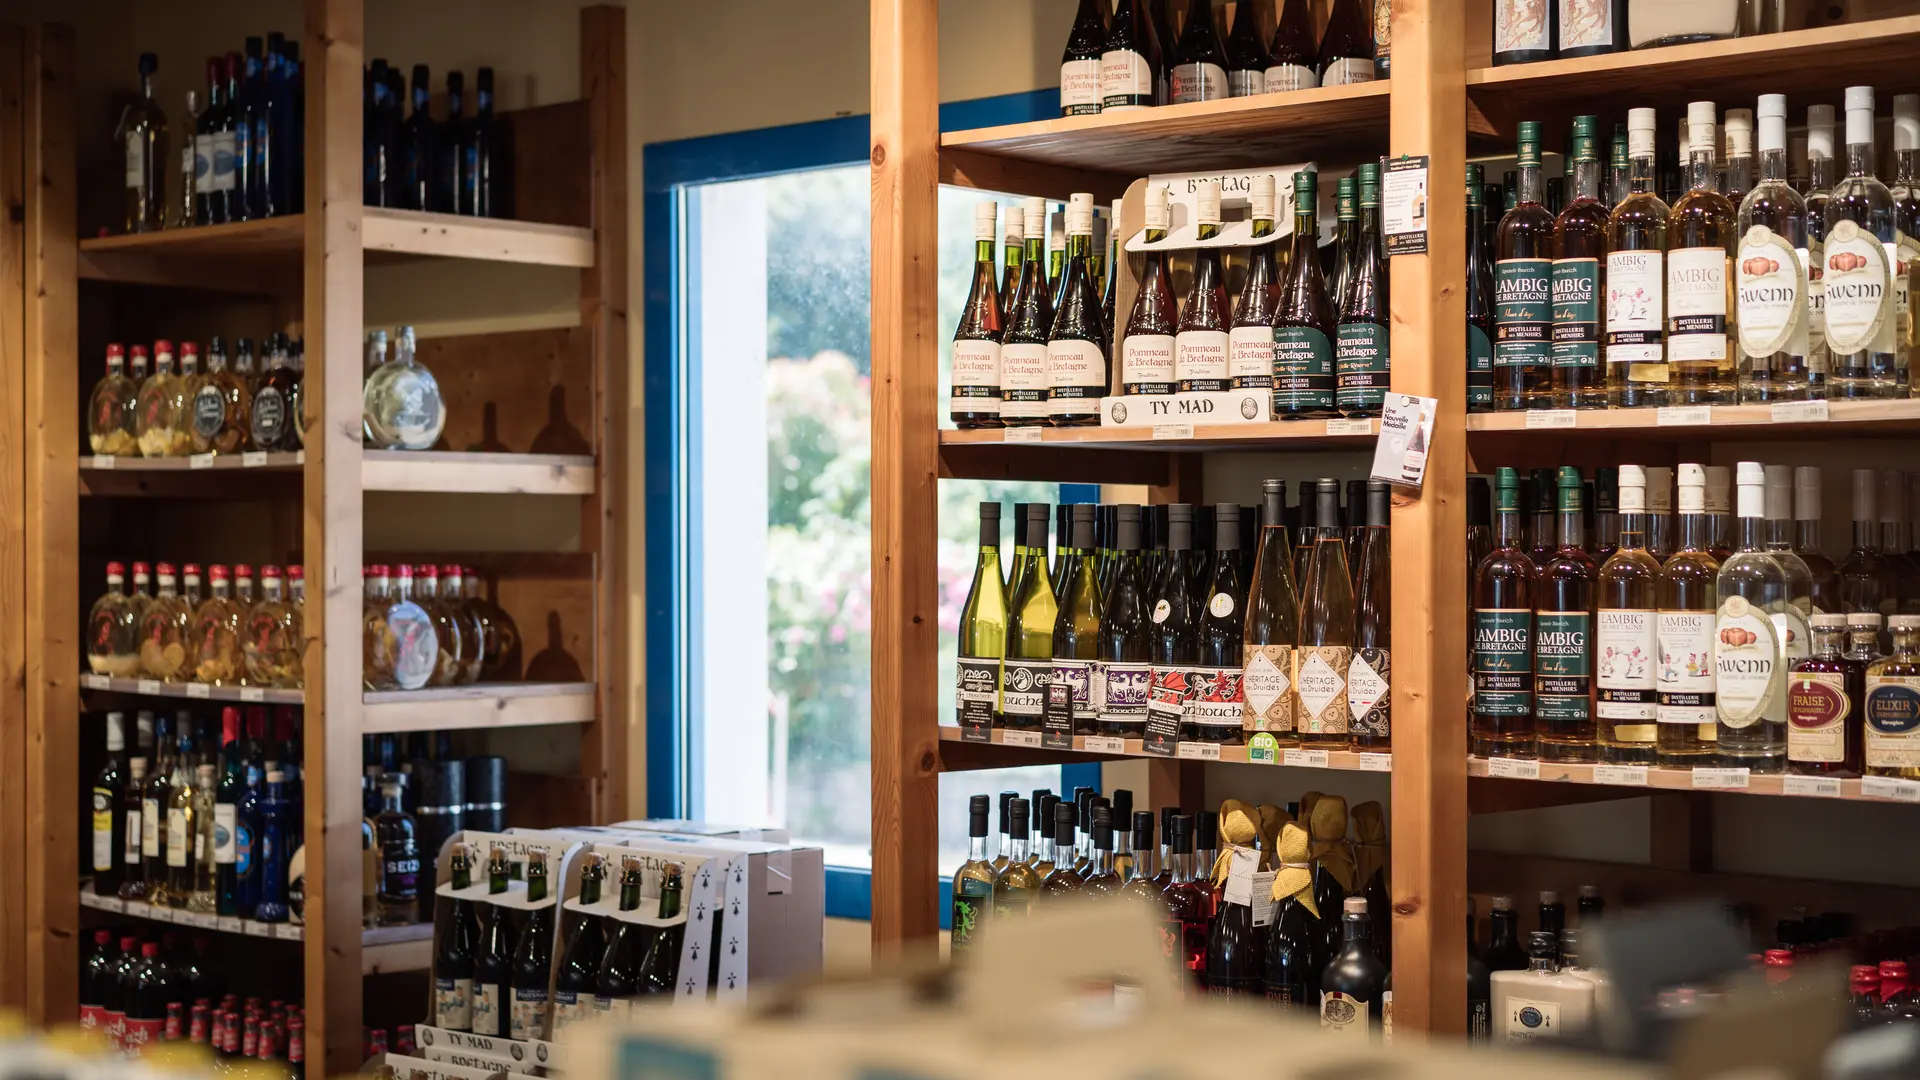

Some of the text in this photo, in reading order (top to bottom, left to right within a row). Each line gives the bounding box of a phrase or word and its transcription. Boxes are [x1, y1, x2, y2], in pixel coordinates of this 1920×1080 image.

[1608, 256, 1646, 267] LAMBIG
[1496, 278, 1548, 294] LAMBIG
[1503, 292, 1547, 300] BRETAGNE
[1232, 341, 1270, 349] Pommeau
[1272, 341, 1310, 350] Pommeau
[1338, 338, 1373, 346] Pommeau
[1130, 348, 1168, 357] Pommeau
[1181, 345, 1220, 353] Pommeau
[1341, 347, 1377, 356] Bretagne
[1187, 355, 1224, 364] Bretagne
[1238, 351, 1272, 360] Bretagn
[1277, 351, 1314, 360] Bretagne
[1004, 356, 1040, 365] Pommeau
[1136, 358, 1172, 367] Bretagne
[960, 362, 994, 371] Bretagne
[1008, 366, 1044, 375] Bretagne
[1054, 362, 1088, 371] Bretagne
[1150, 399, 1214, 414] TY MAD
[1386, 406, 1396, 414] Une
[1384, 414, 1408, 423] Nouvelle
[1601, 614, 1643, 625] LAMBIG
[1661, 616, 1701, 627] LAMBIG
[1475, 628, 1527, 642] LAMBIG
[1481, 642, 1526, 650] BRETAGNE
[1542, 646, 1583, 654] BRETAGNE
[1246, 674, 1280, 683] L'HÉRITAGE
[1300, 676, 1335, 685] L'HÉRITAGE
[1793, 696, 1824, 706] FRAISE
[1876, 700, 1912, 711] ELIXIR
[1254, 737, 1272, 747] BIO
[447, 1032, 492, 1050] TY MAD
